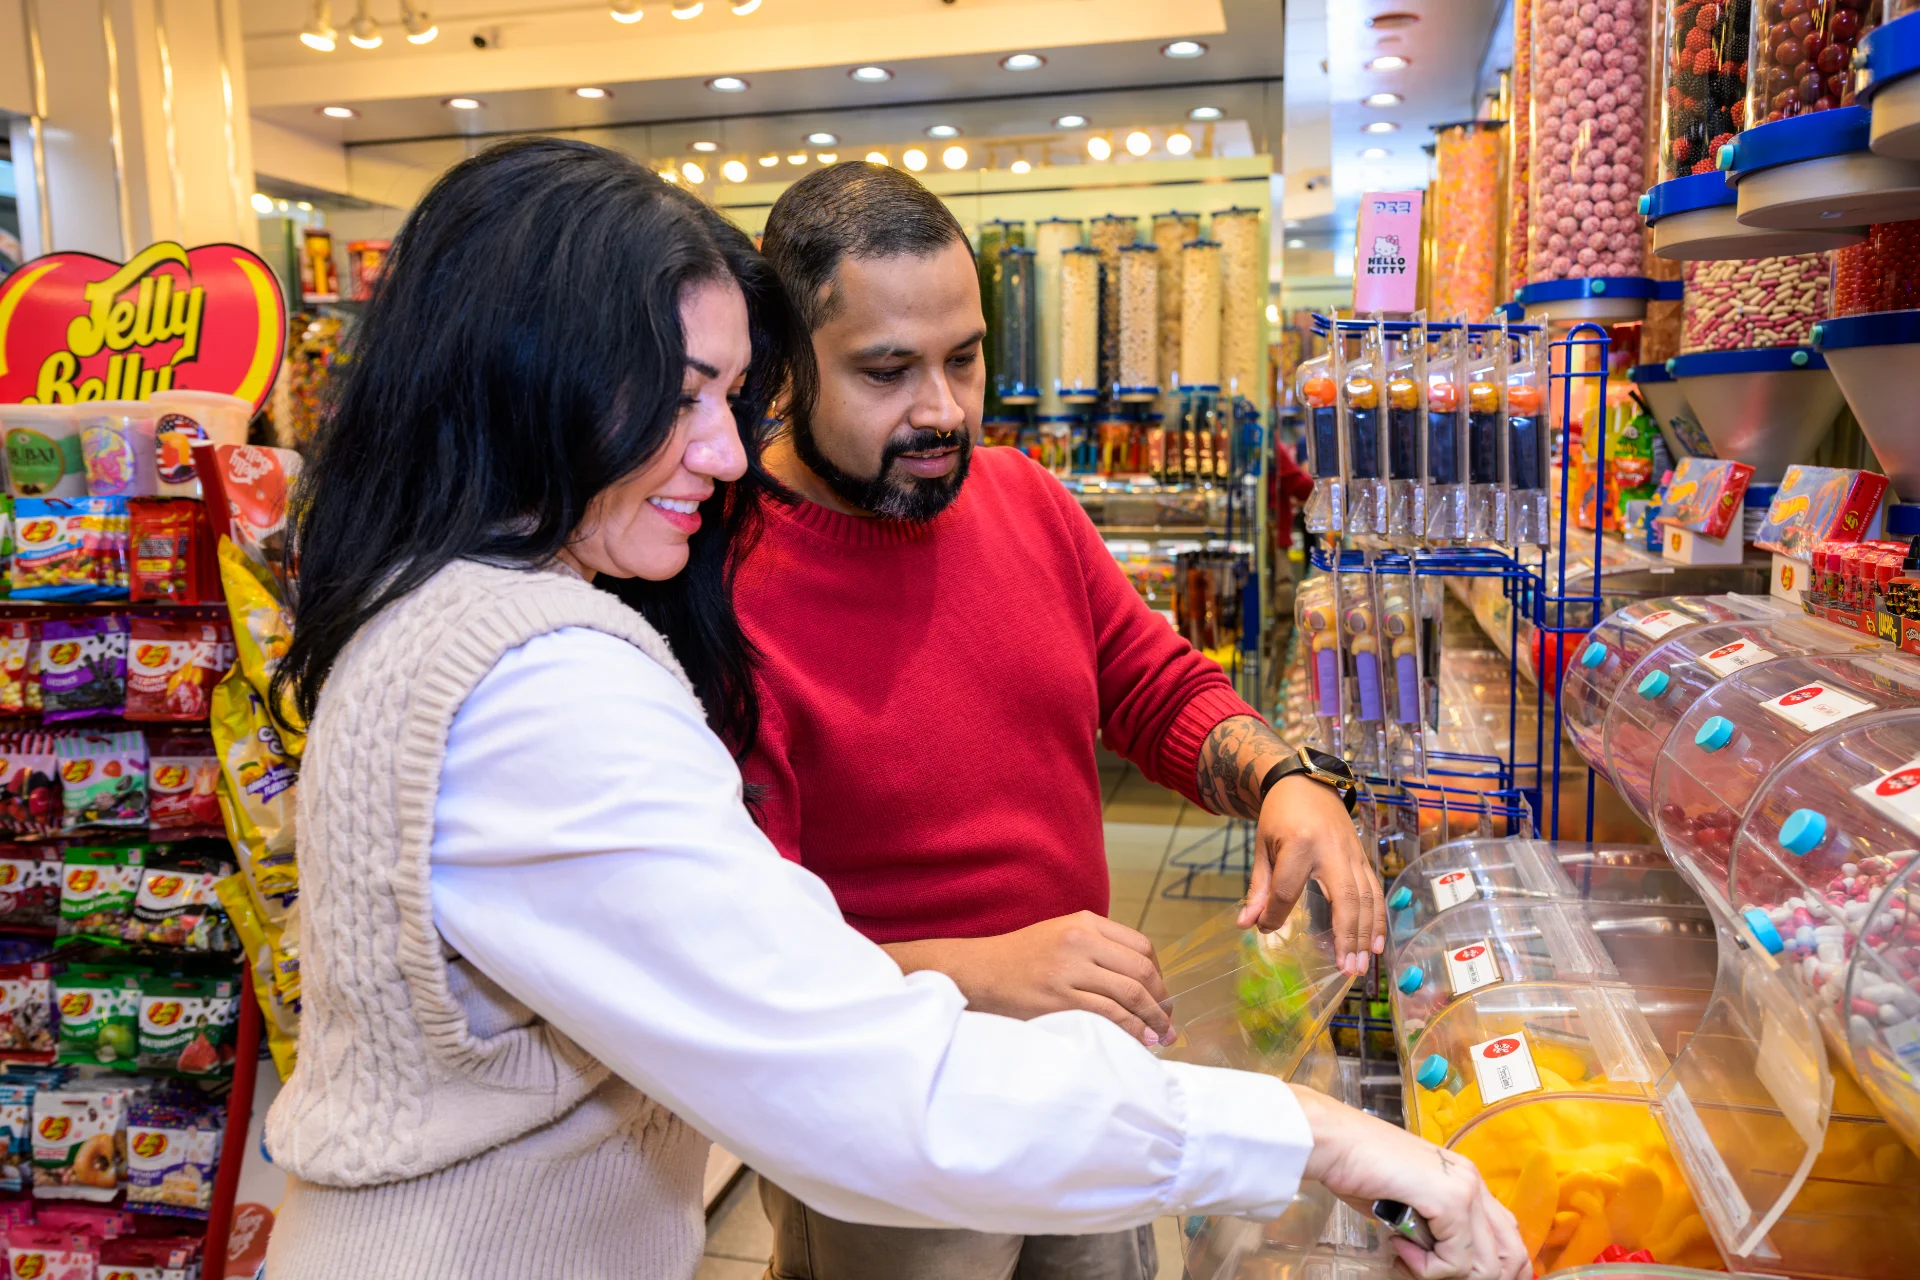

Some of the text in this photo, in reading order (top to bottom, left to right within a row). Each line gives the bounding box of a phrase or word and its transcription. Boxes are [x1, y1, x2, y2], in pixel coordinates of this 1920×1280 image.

[1368, 257, 1406, 265] HELLO
[1367, 266, 1406, 275] KITTY
[67, 241, 206, 367] Jelly
